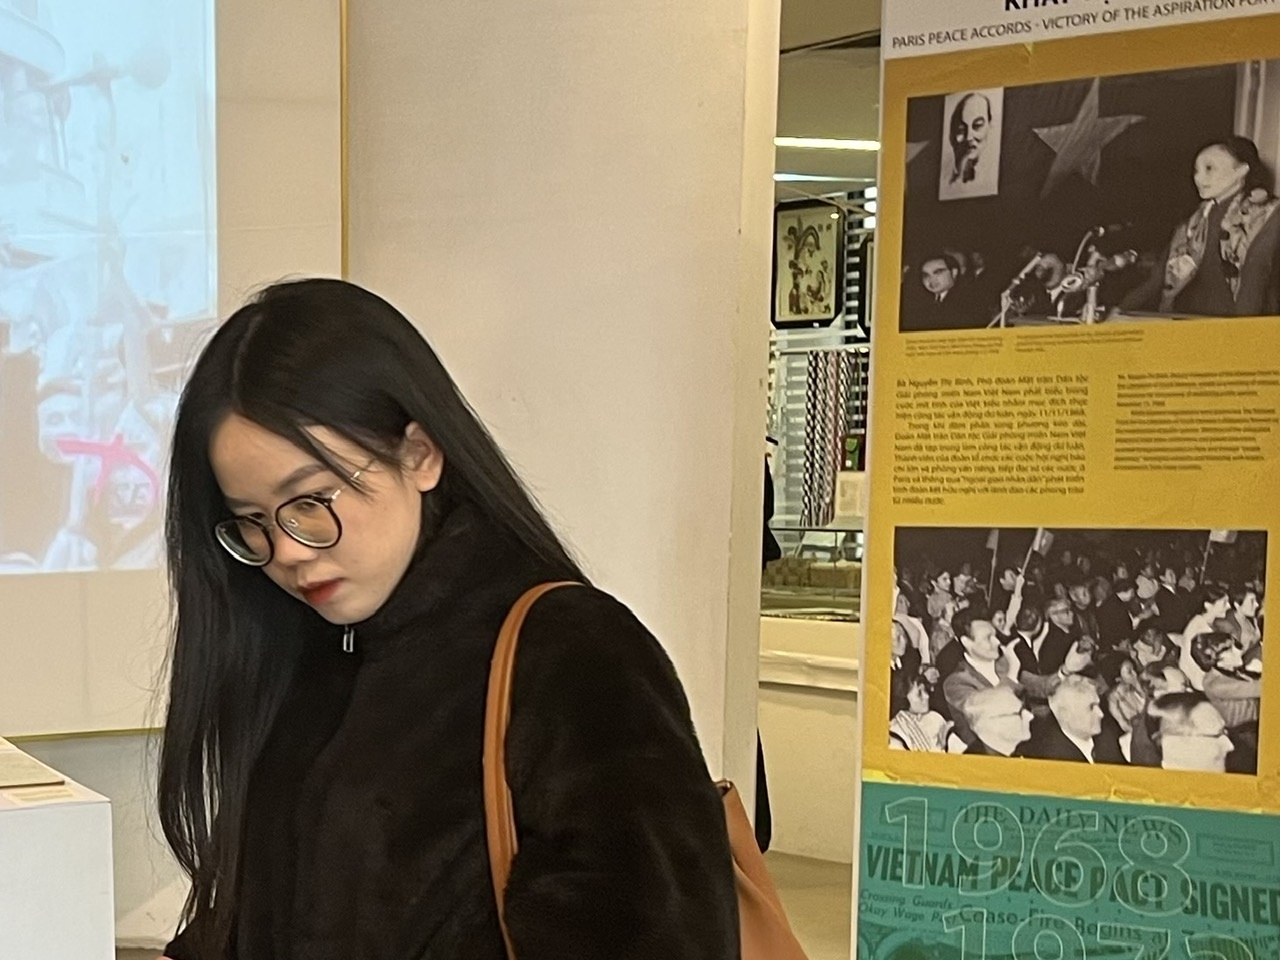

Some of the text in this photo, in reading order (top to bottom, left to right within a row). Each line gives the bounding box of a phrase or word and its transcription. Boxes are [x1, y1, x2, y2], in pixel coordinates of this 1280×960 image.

[892, 33, 926, 48] PARIS
[928, 28, 967, 44] PEACE
[970, 20, 1032, 39] ACCORDS
[1041, 12, 1098, 31] VICTORY
[1102, 10, 1120, 23] OF
[1123, 5, 1150, 20] THE
[1152, 0, 1235, 18] ASPIRATION
[958, 804, 1006, 824] THE
[867, 844, 979, 890] VIETNAM
[990, 855, 1079, 900] PEACE
[1090, 866, 1168, 910] PACT
[885, 797, 1191, 918] 1968
